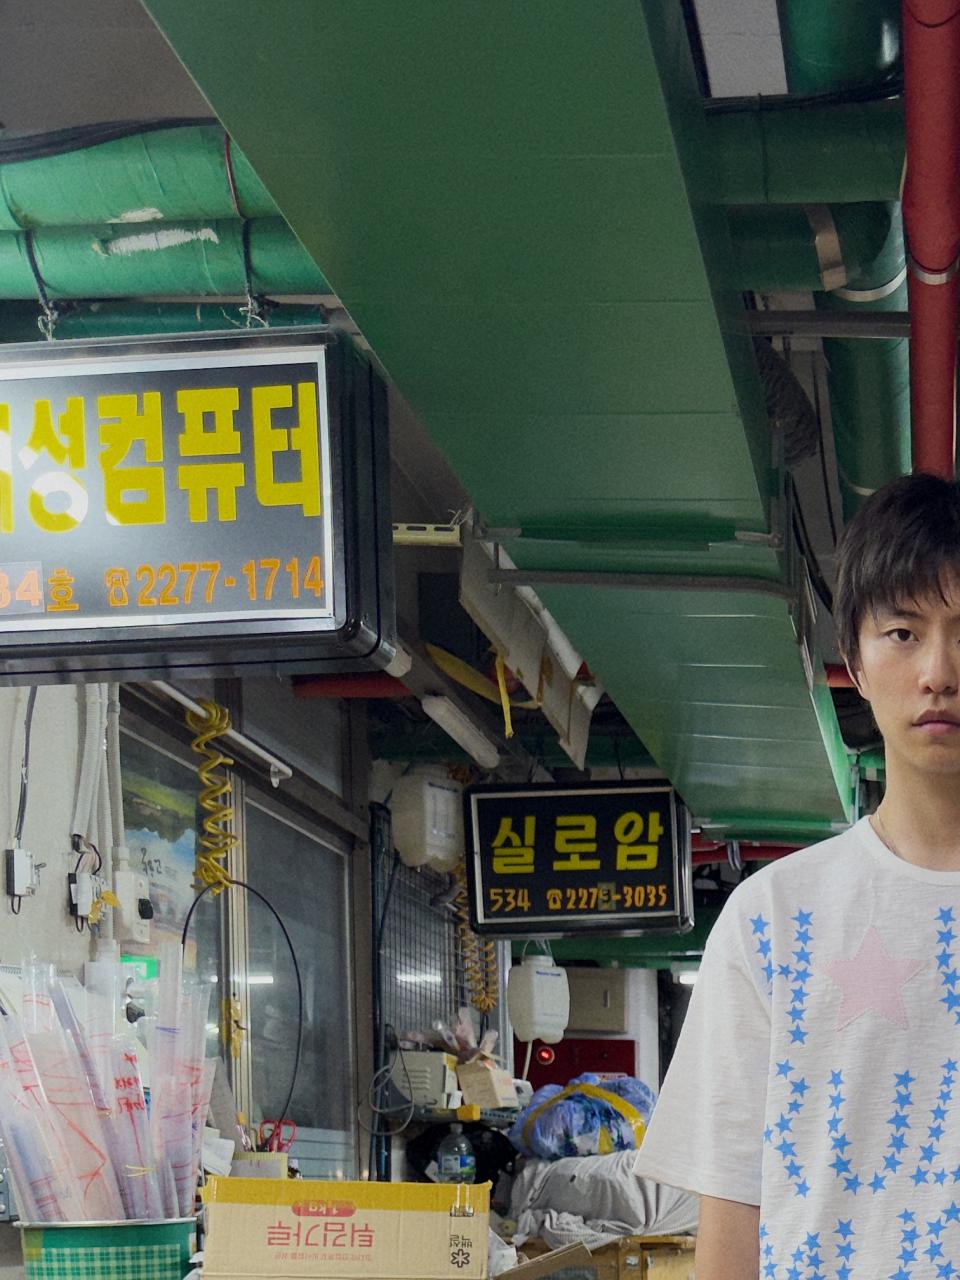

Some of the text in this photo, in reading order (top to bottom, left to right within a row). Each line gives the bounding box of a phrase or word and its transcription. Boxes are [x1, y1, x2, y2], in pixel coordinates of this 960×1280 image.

[0, 382, 321, 534] 성컴퓨터
[491, 811, 665, 874] 실로암
[490, 888, 531, 912] 534
[267, 1221, 375, 1248] 튀김가루
